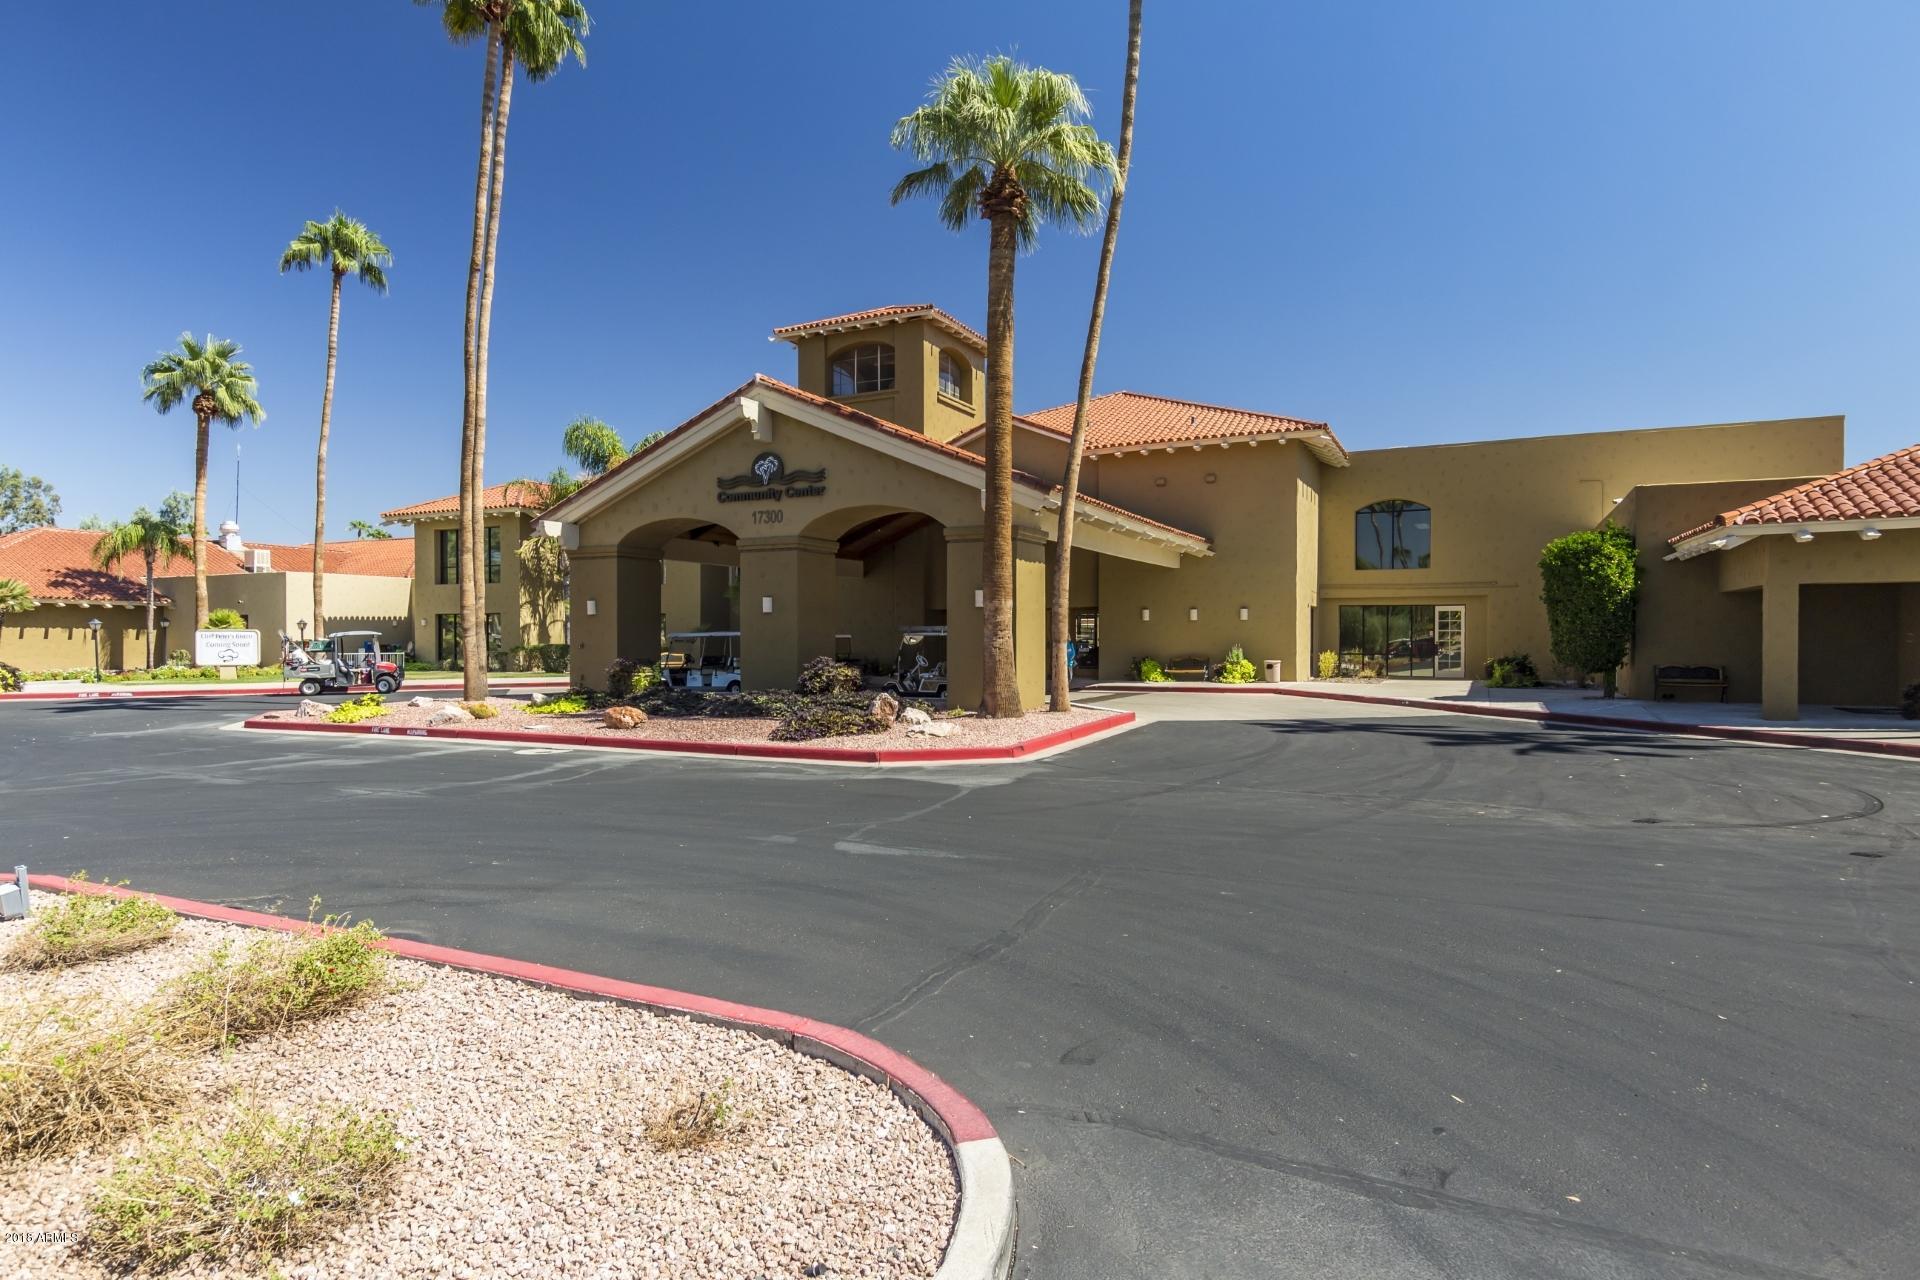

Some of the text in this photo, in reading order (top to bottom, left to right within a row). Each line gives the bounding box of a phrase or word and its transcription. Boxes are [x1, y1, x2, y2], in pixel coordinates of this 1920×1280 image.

[717, 485, 826, 503] Community Center
[752, 510, 784, 524] 17300
